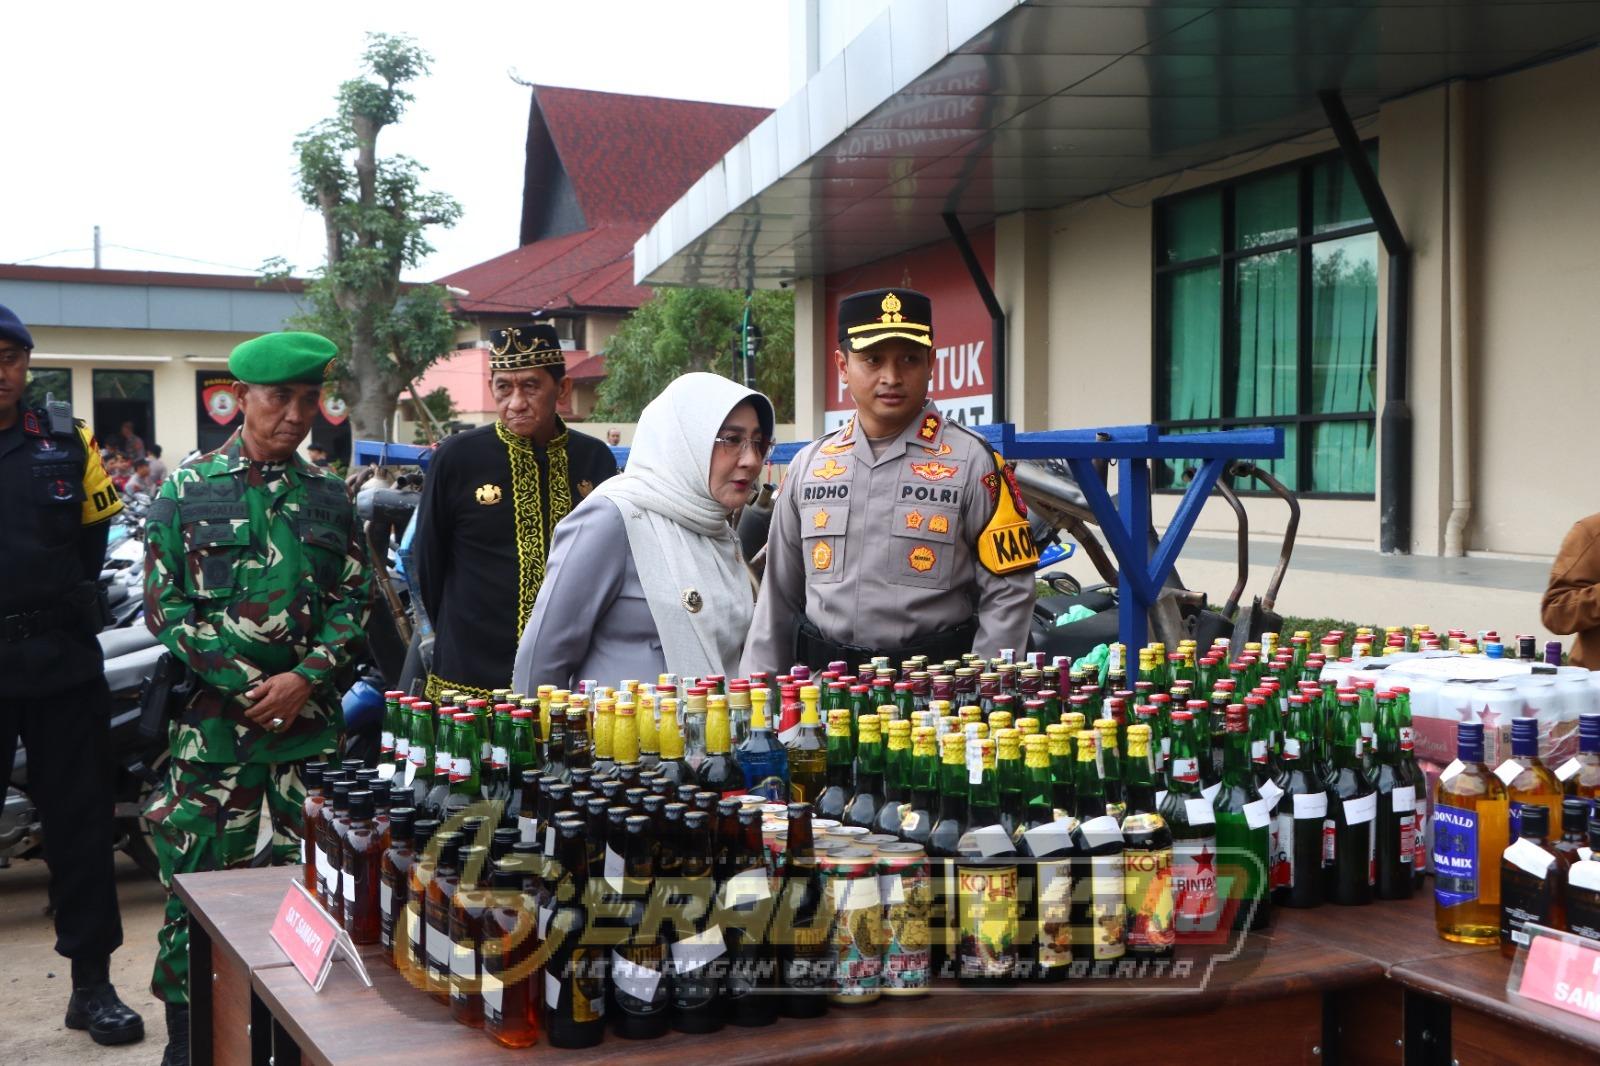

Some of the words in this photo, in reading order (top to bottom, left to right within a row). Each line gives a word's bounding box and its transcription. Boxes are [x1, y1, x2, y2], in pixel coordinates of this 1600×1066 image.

[803, 484, 849, 500] RIDHO
[901, 485, 959, 504] POLRI
[1451, 857, 1473, 869] MIX
